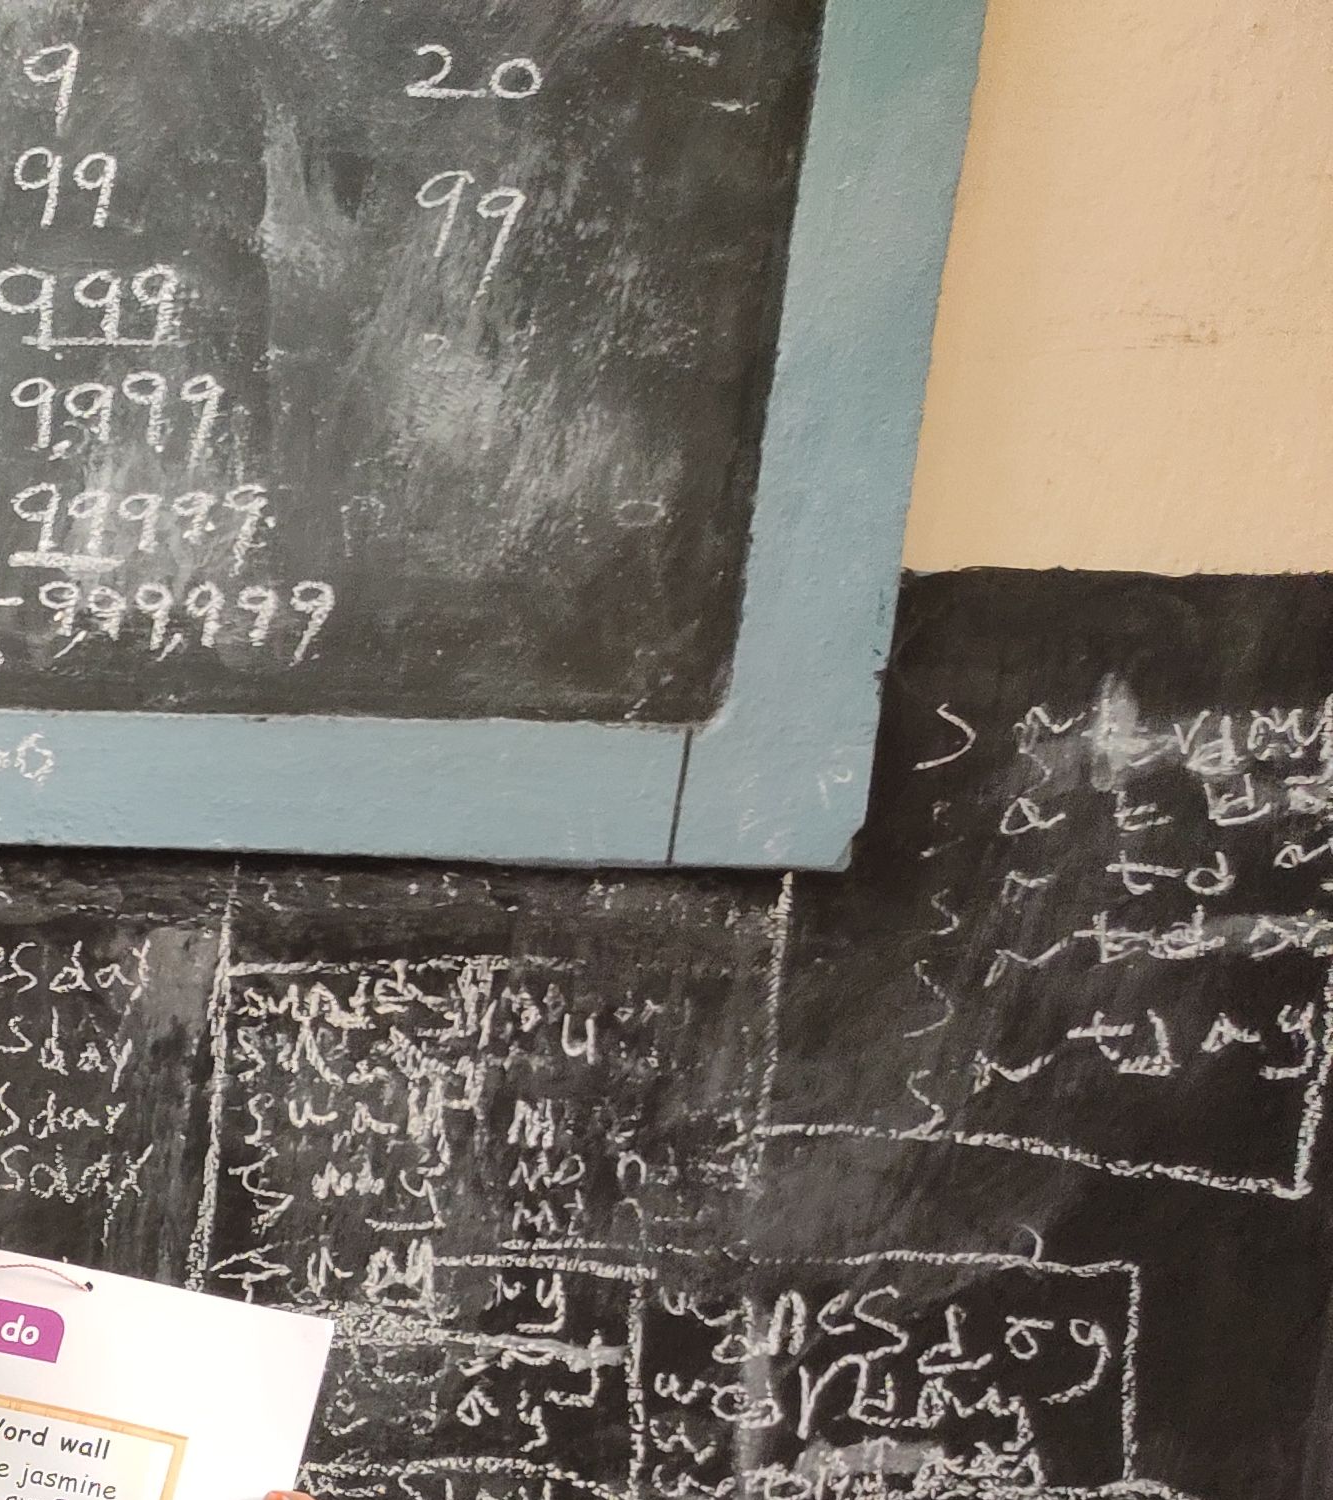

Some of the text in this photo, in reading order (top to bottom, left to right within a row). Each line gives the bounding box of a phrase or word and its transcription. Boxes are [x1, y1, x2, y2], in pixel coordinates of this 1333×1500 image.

[24, 42, 79, 136] 9
[405, 44, 544, 99] 20
[13, 146, 117, 227] 99
[416, 170, 527, 306] 99
[0, 1314, 40, 1345] do
[59, 1434, 111, 1461] wall
[16, 1463, 117, 1500] jasmine
